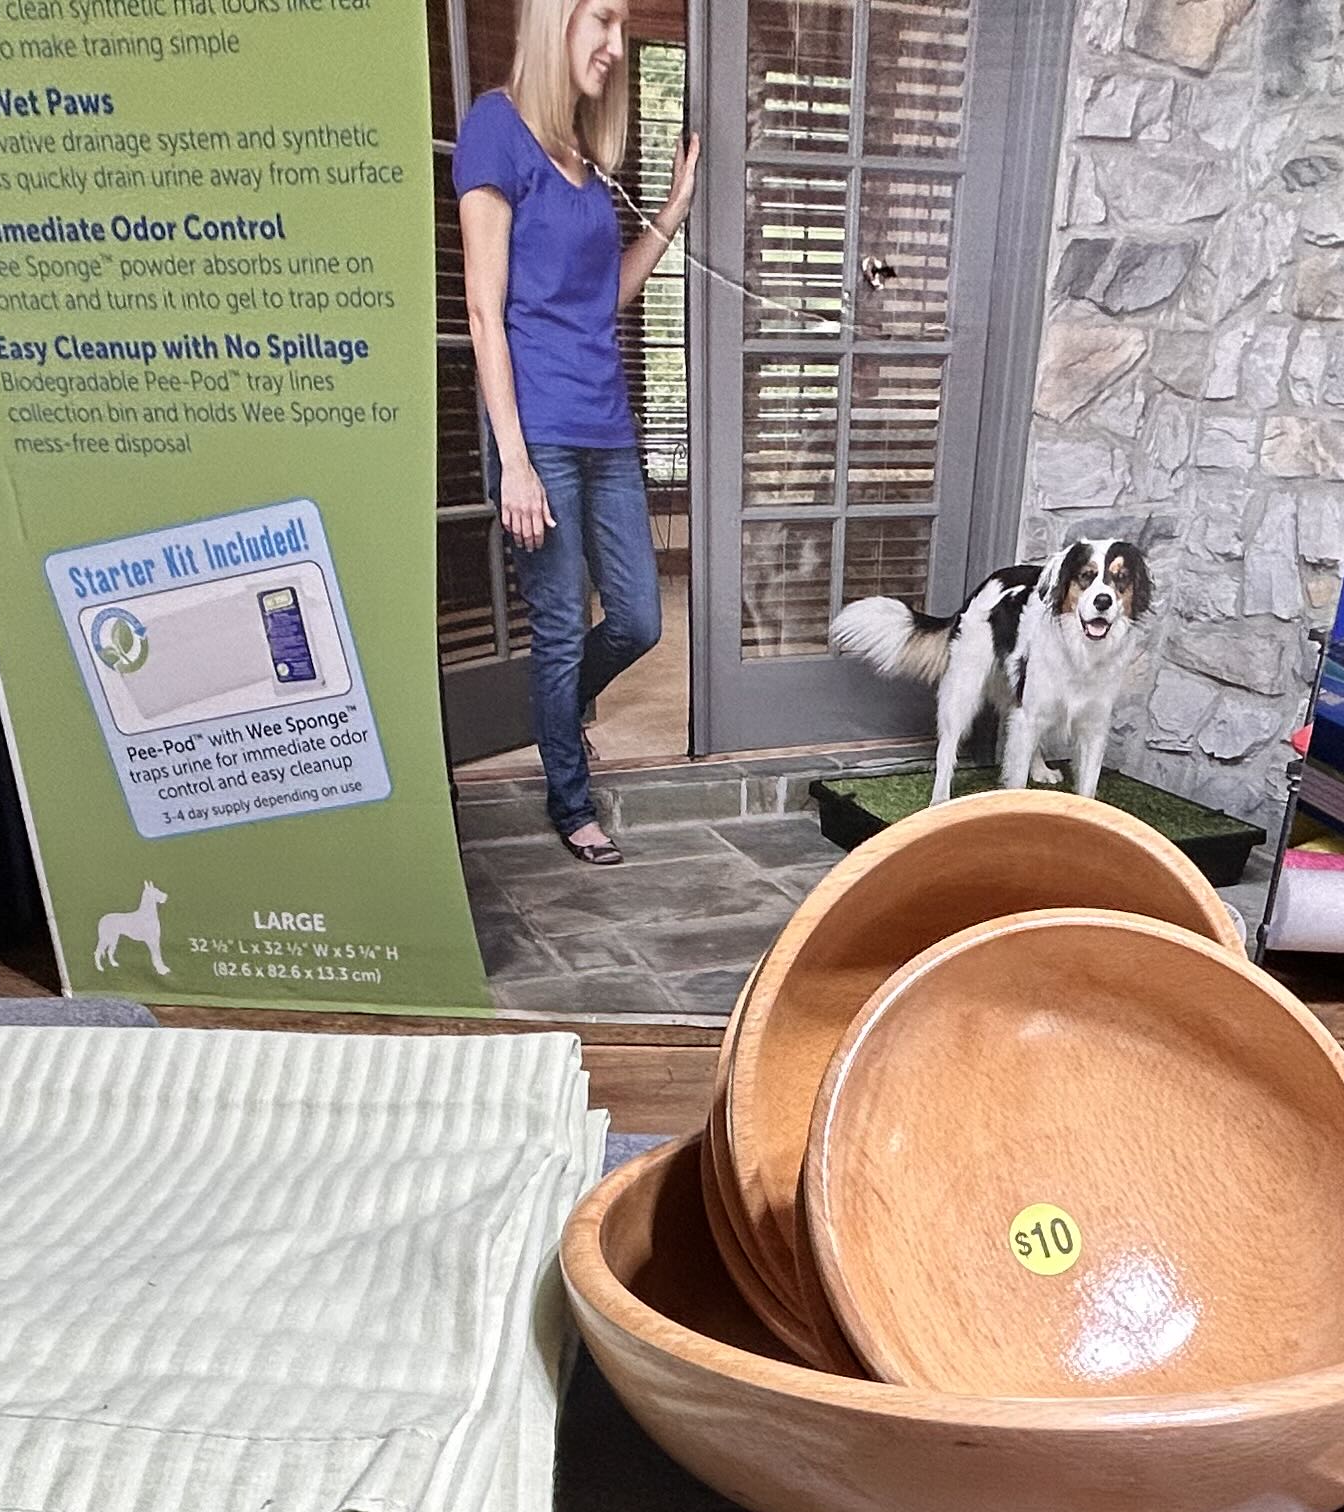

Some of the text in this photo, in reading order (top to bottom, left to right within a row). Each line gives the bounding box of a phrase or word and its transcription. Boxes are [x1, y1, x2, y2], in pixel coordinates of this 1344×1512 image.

[6, 0, 63, 21] clean
[71, 0, 167, 25] synthetic
[174, 0, 215, 16] mat
[20, 33, 77, 58] make
[83, 33, 164, 62] training
[170, 28, 240, 58] simple
[45, 86, 115, 116] Paws
[62, 129, 151, 158] drainage
[158, 127, 231, 157] system
[237, 125, 275, 150] and
[282, 123, 379, 155] synthetic
[17, 165, 87, 195] quickly
[94, 165, 145, 188] drain
[152, 162, 203, 188] urine
[210, 165, 262, 192] away
[269, 161, 320, 186] from
[327, 160, 403, 184] surface
[111, 214, 177, 242] Odor
[184, 212, 286, 241] Control
[121, 253, 196, 280] powder
[203, 252, 282, 276] absorbs
[288, 251, 340, 275] urine
[346, 255, 374, 274] on
[65, 288, 101, 311] and
[108, 289, 157, 310] turns
[162, 287, 177, 310] it
[181, 287, 219, 310] into
[226, 287, 256, 314] gel
[262, 287, 283, 309] to
[288, 288, 329, 313] trap
[335, 286, 395, 308] odors
[54, 334, 157, 366] Cleanup
[162, 333, 219, 360] with
[224, 333, 261, 359] No
[266, 332, 369, 366] Spillage
[0, 370, 139, 397] Biodegradable
[247, 371, 283, 396] tray
[289, 369, 335, 391] lines
[8, 401, 399, 427] collection bin and holds Wee Sponge for
[14, 432, 192, 456] mess-free disposal
[68, 517, 309, 599] Starter Kit Included!
[208, 728, 243, 747] with
[245, 721, 282, 740] Wee
[129, 728, 369, 785] traps urine for immediate odor
[158, 754, 353, 800] control and easy cleanup
[162, 781, 363, 825] 3-4 day supply depending on use
[253, 911, 327, 932] LARGE
[188, 937, 209, 953] 32
[238, 940, 249, 954] L
[250, 943, 261, 954] x
[263, 941, 284, 956] 32
[312, 943, 329, 958] W
[333, 947, 342, 958] x
[346, 944, 356, 959] 5
[386, 946, 399, 961] H
[212, 961, 382, 984] (82.6 x 82.6 x 13.3 cm)
[1015, 1217, 1074, 1259] $10
